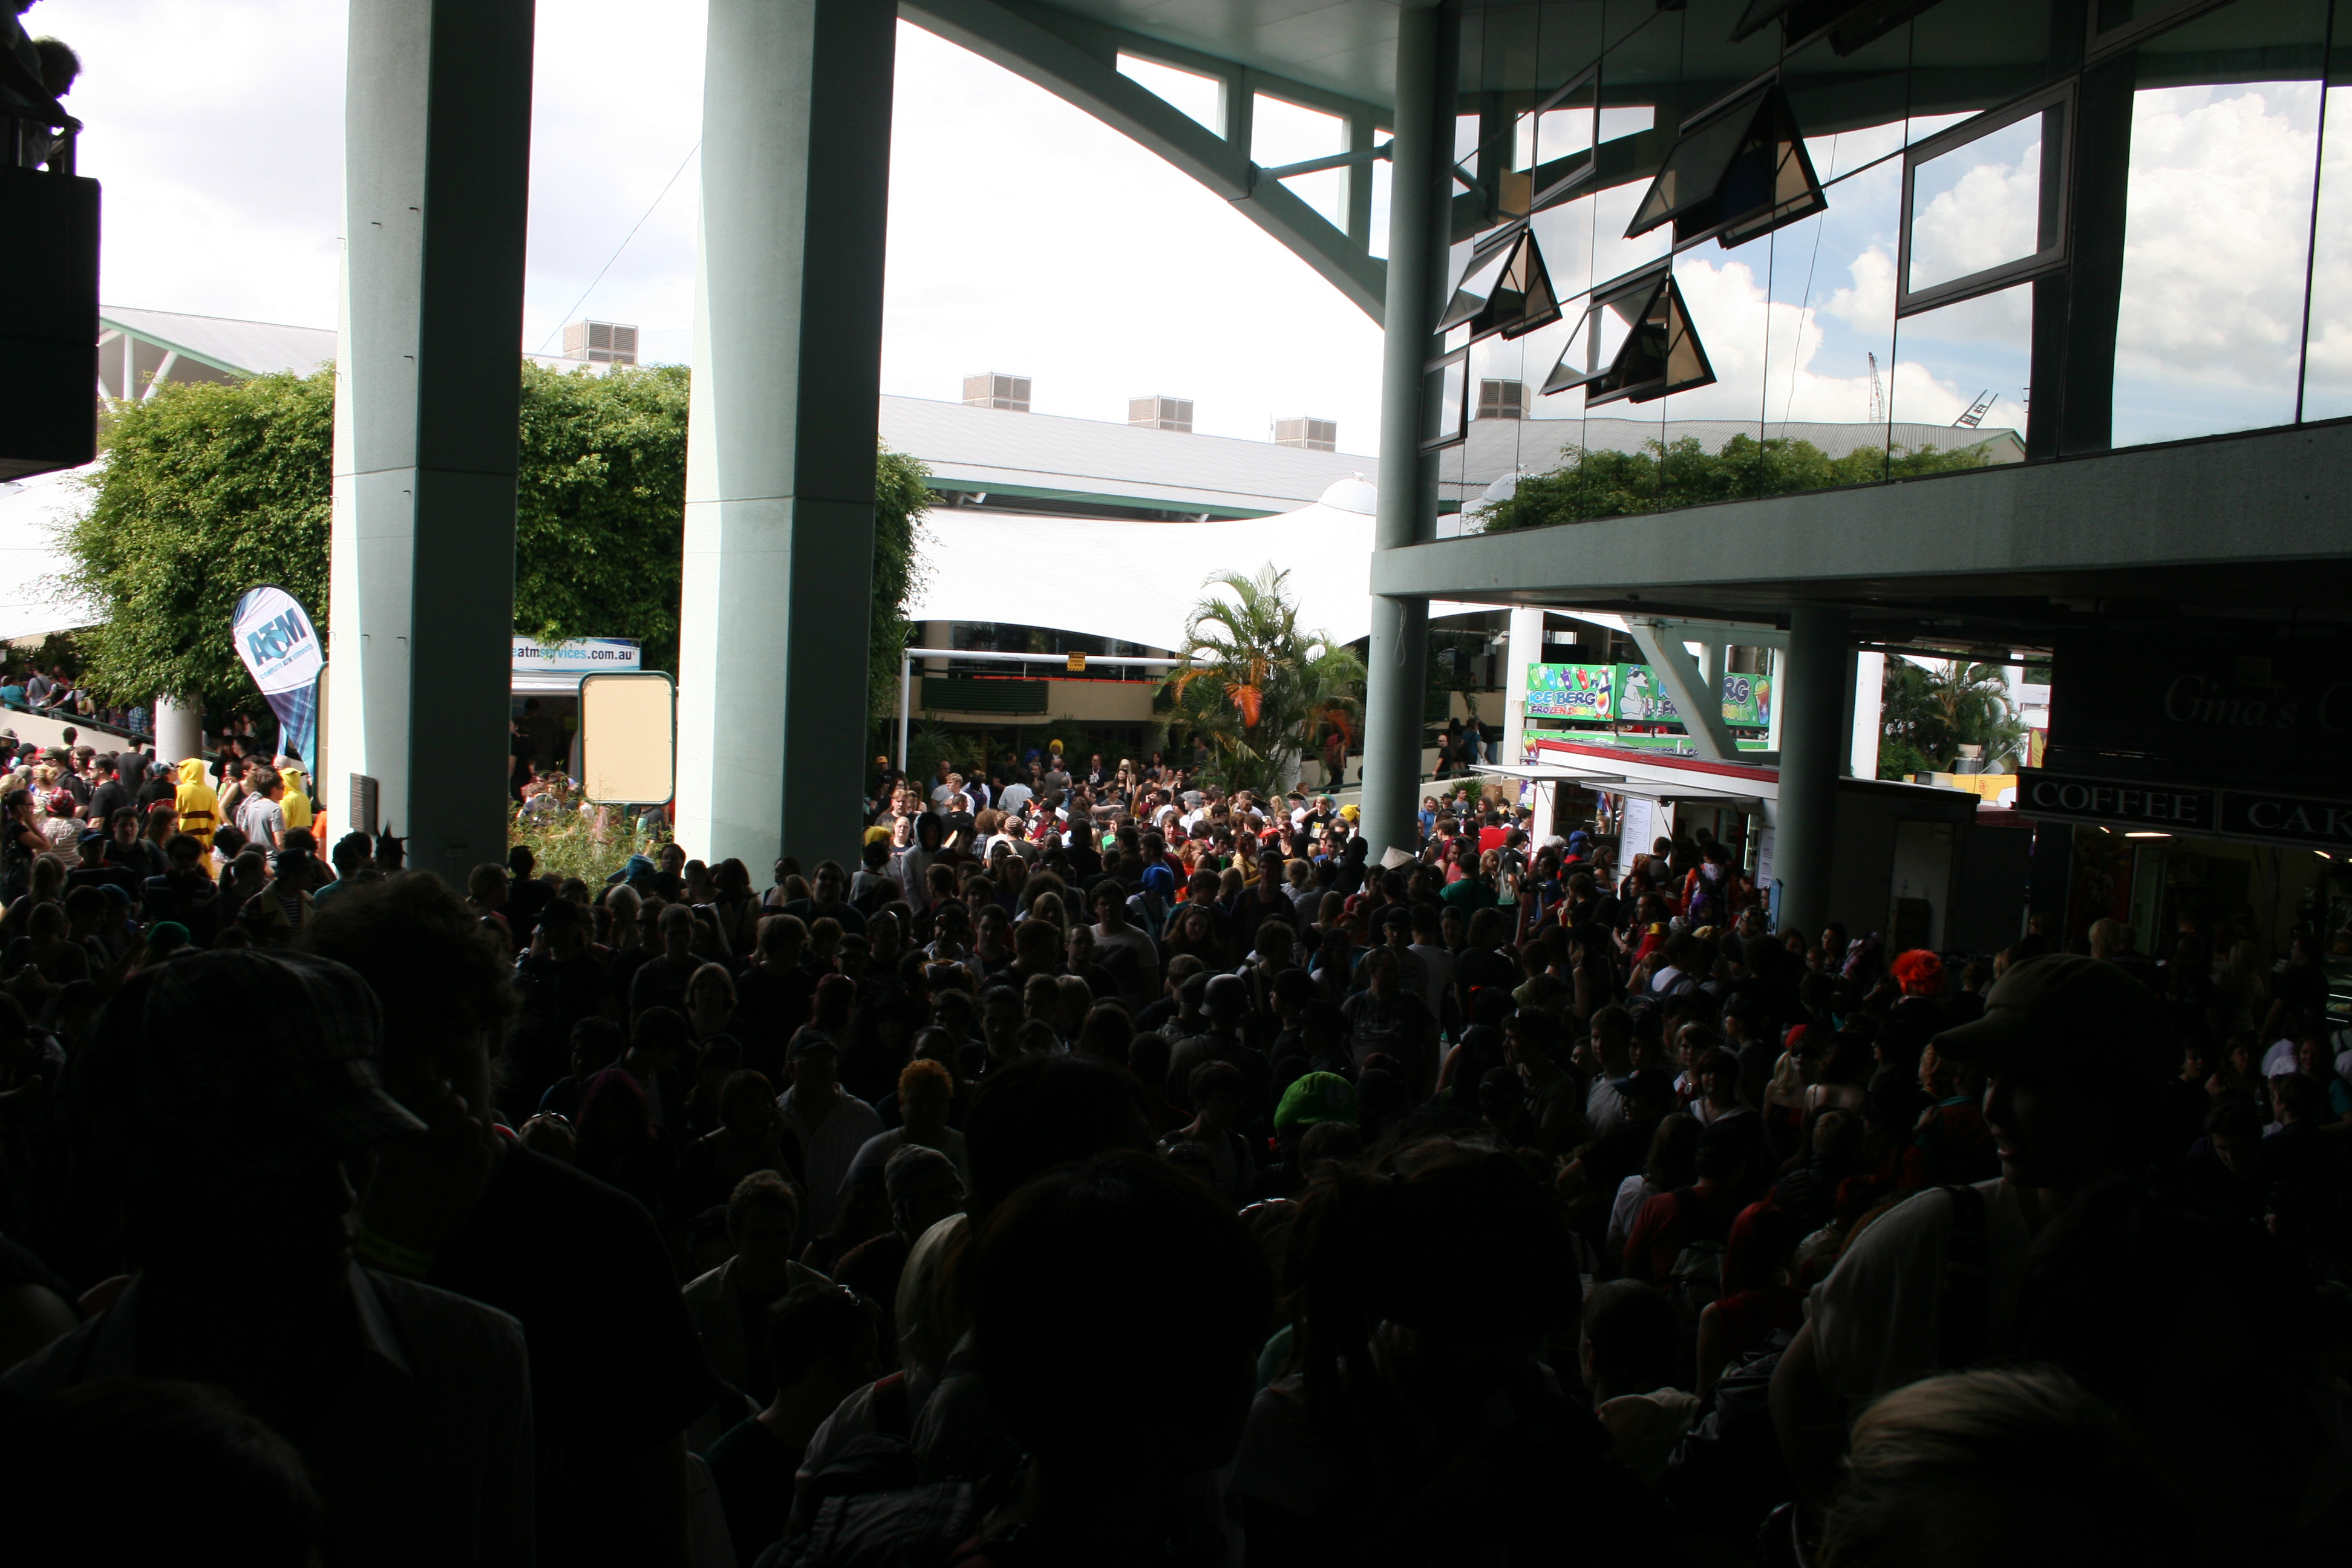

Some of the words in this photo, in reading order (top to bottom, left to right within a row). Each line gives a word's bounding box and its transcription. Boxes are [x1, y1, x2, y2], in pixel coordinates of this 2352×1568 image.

[247, 607, 307, 667] ATM
[283, 656, 293, 666] ATM
[1528, 690, 1553, 705] ICE
[1554, 691, 1597, 706] BERG
[1531, 705, 1567, 715] FROZEN
[2164, 674, 2299, 729] Gina's
[2031, 781, 2198, 823] COFFEE
